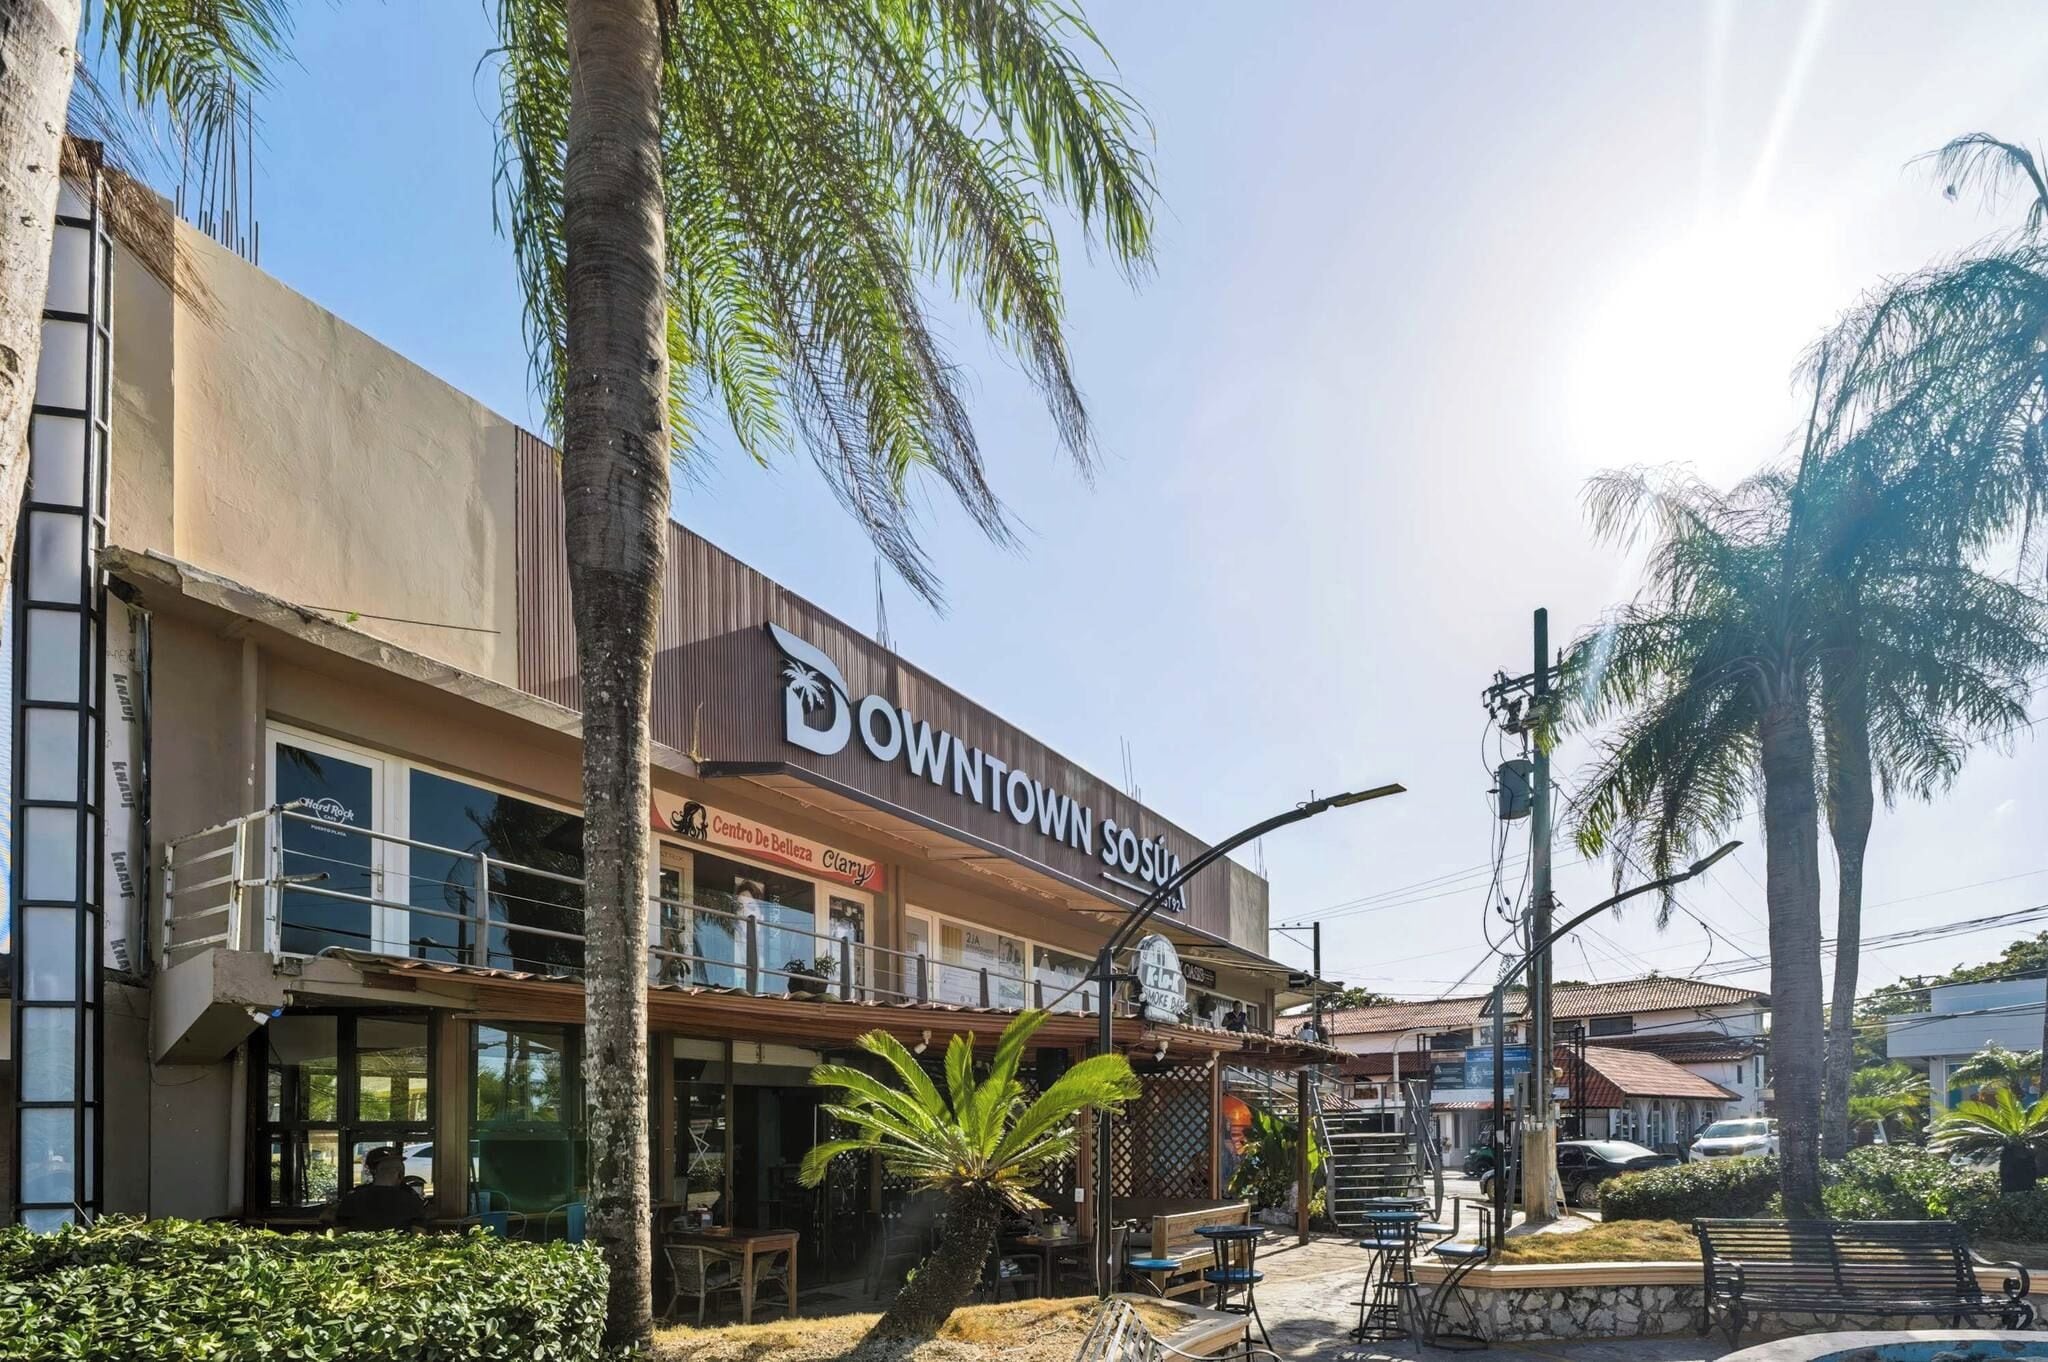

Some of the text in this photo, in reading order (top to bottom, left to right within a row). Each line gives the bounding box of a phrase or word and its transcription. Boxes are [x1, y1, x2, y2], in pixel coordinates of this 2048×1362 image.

[768, 621, 1092, 856] DOWNTOWN
[304, 797, 355, 821] Hard Rock
[712, 815, 874, 886] Centro De Belleza Clary
